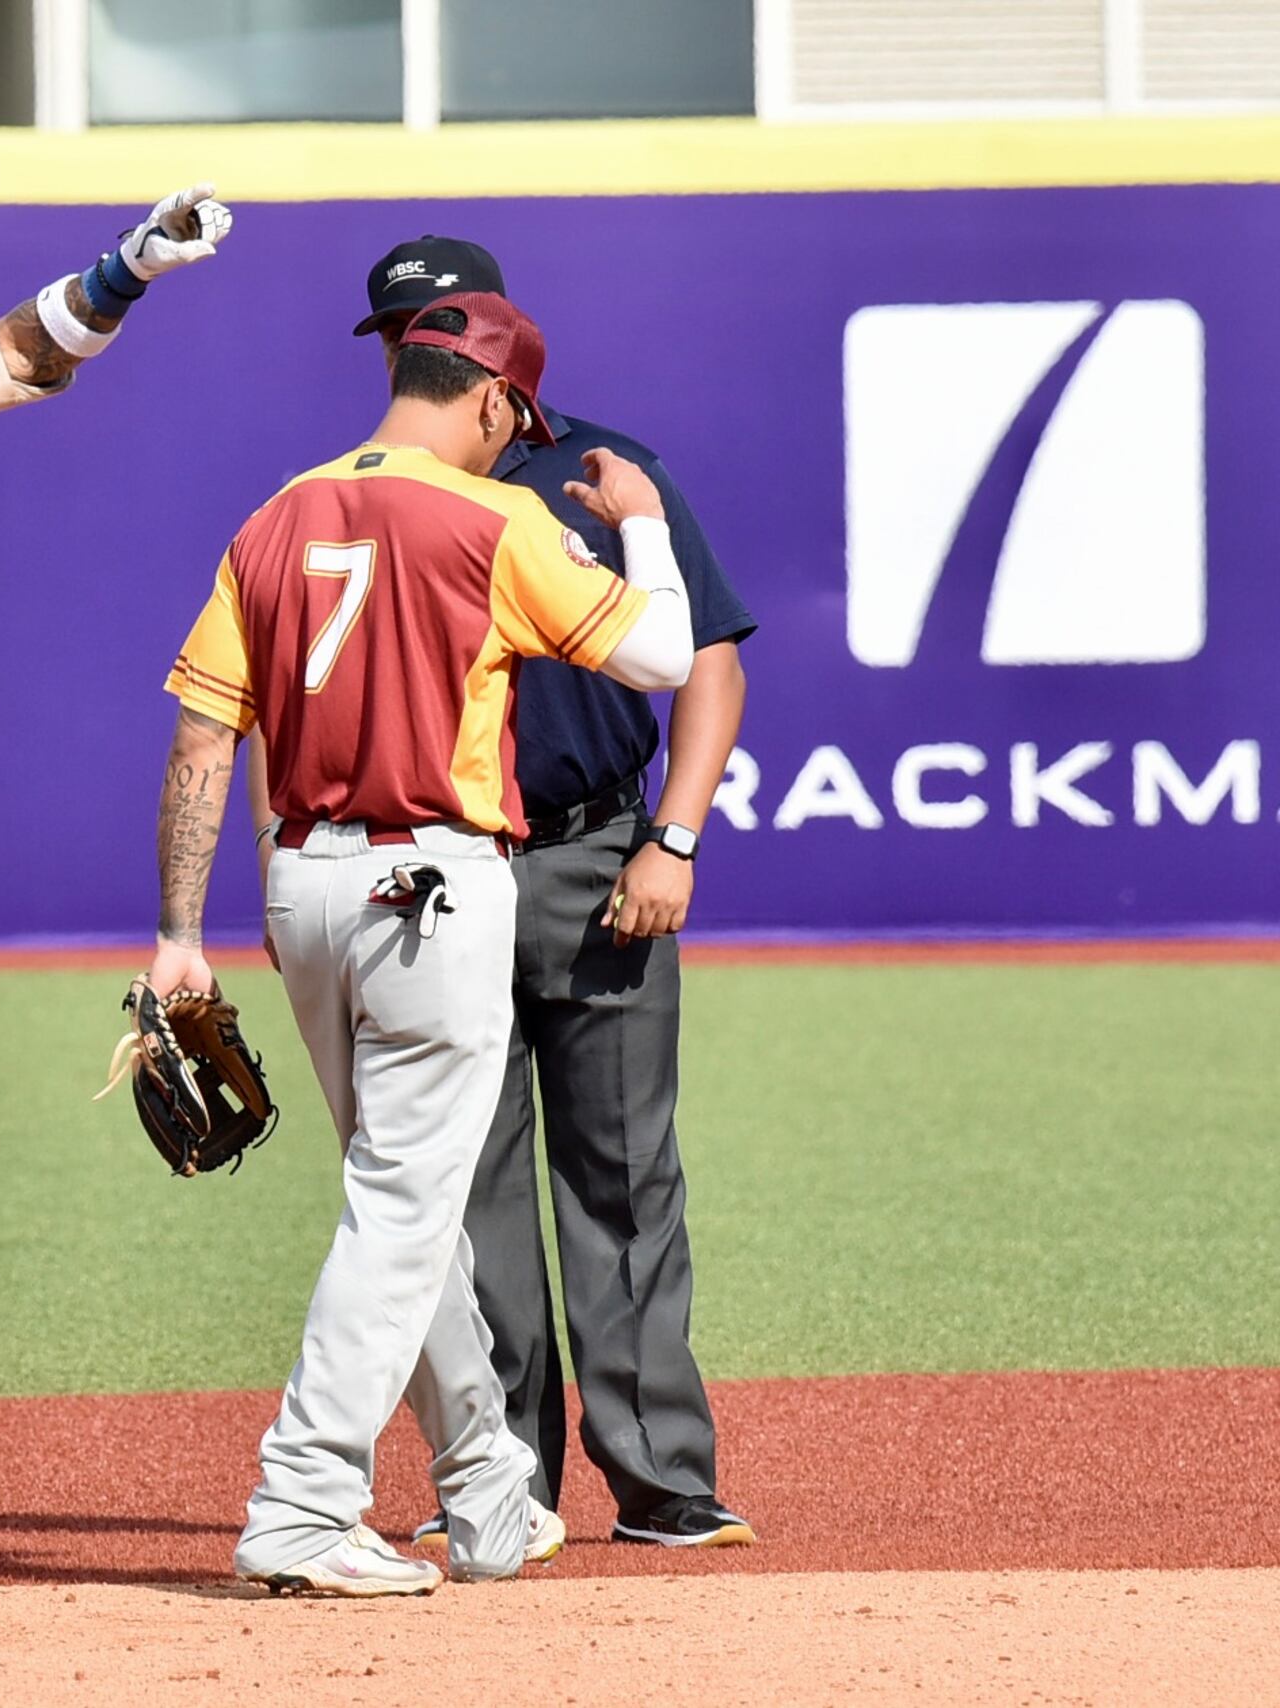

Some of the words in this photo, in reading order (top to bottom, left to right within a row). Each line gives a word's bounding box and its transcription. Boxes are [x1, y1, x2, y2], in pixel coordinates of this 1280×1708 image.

[386, 260, 426, 281] WBSC
[303, 539, 377, 694] 7
[663, 739, 1280, 829] RACKM
